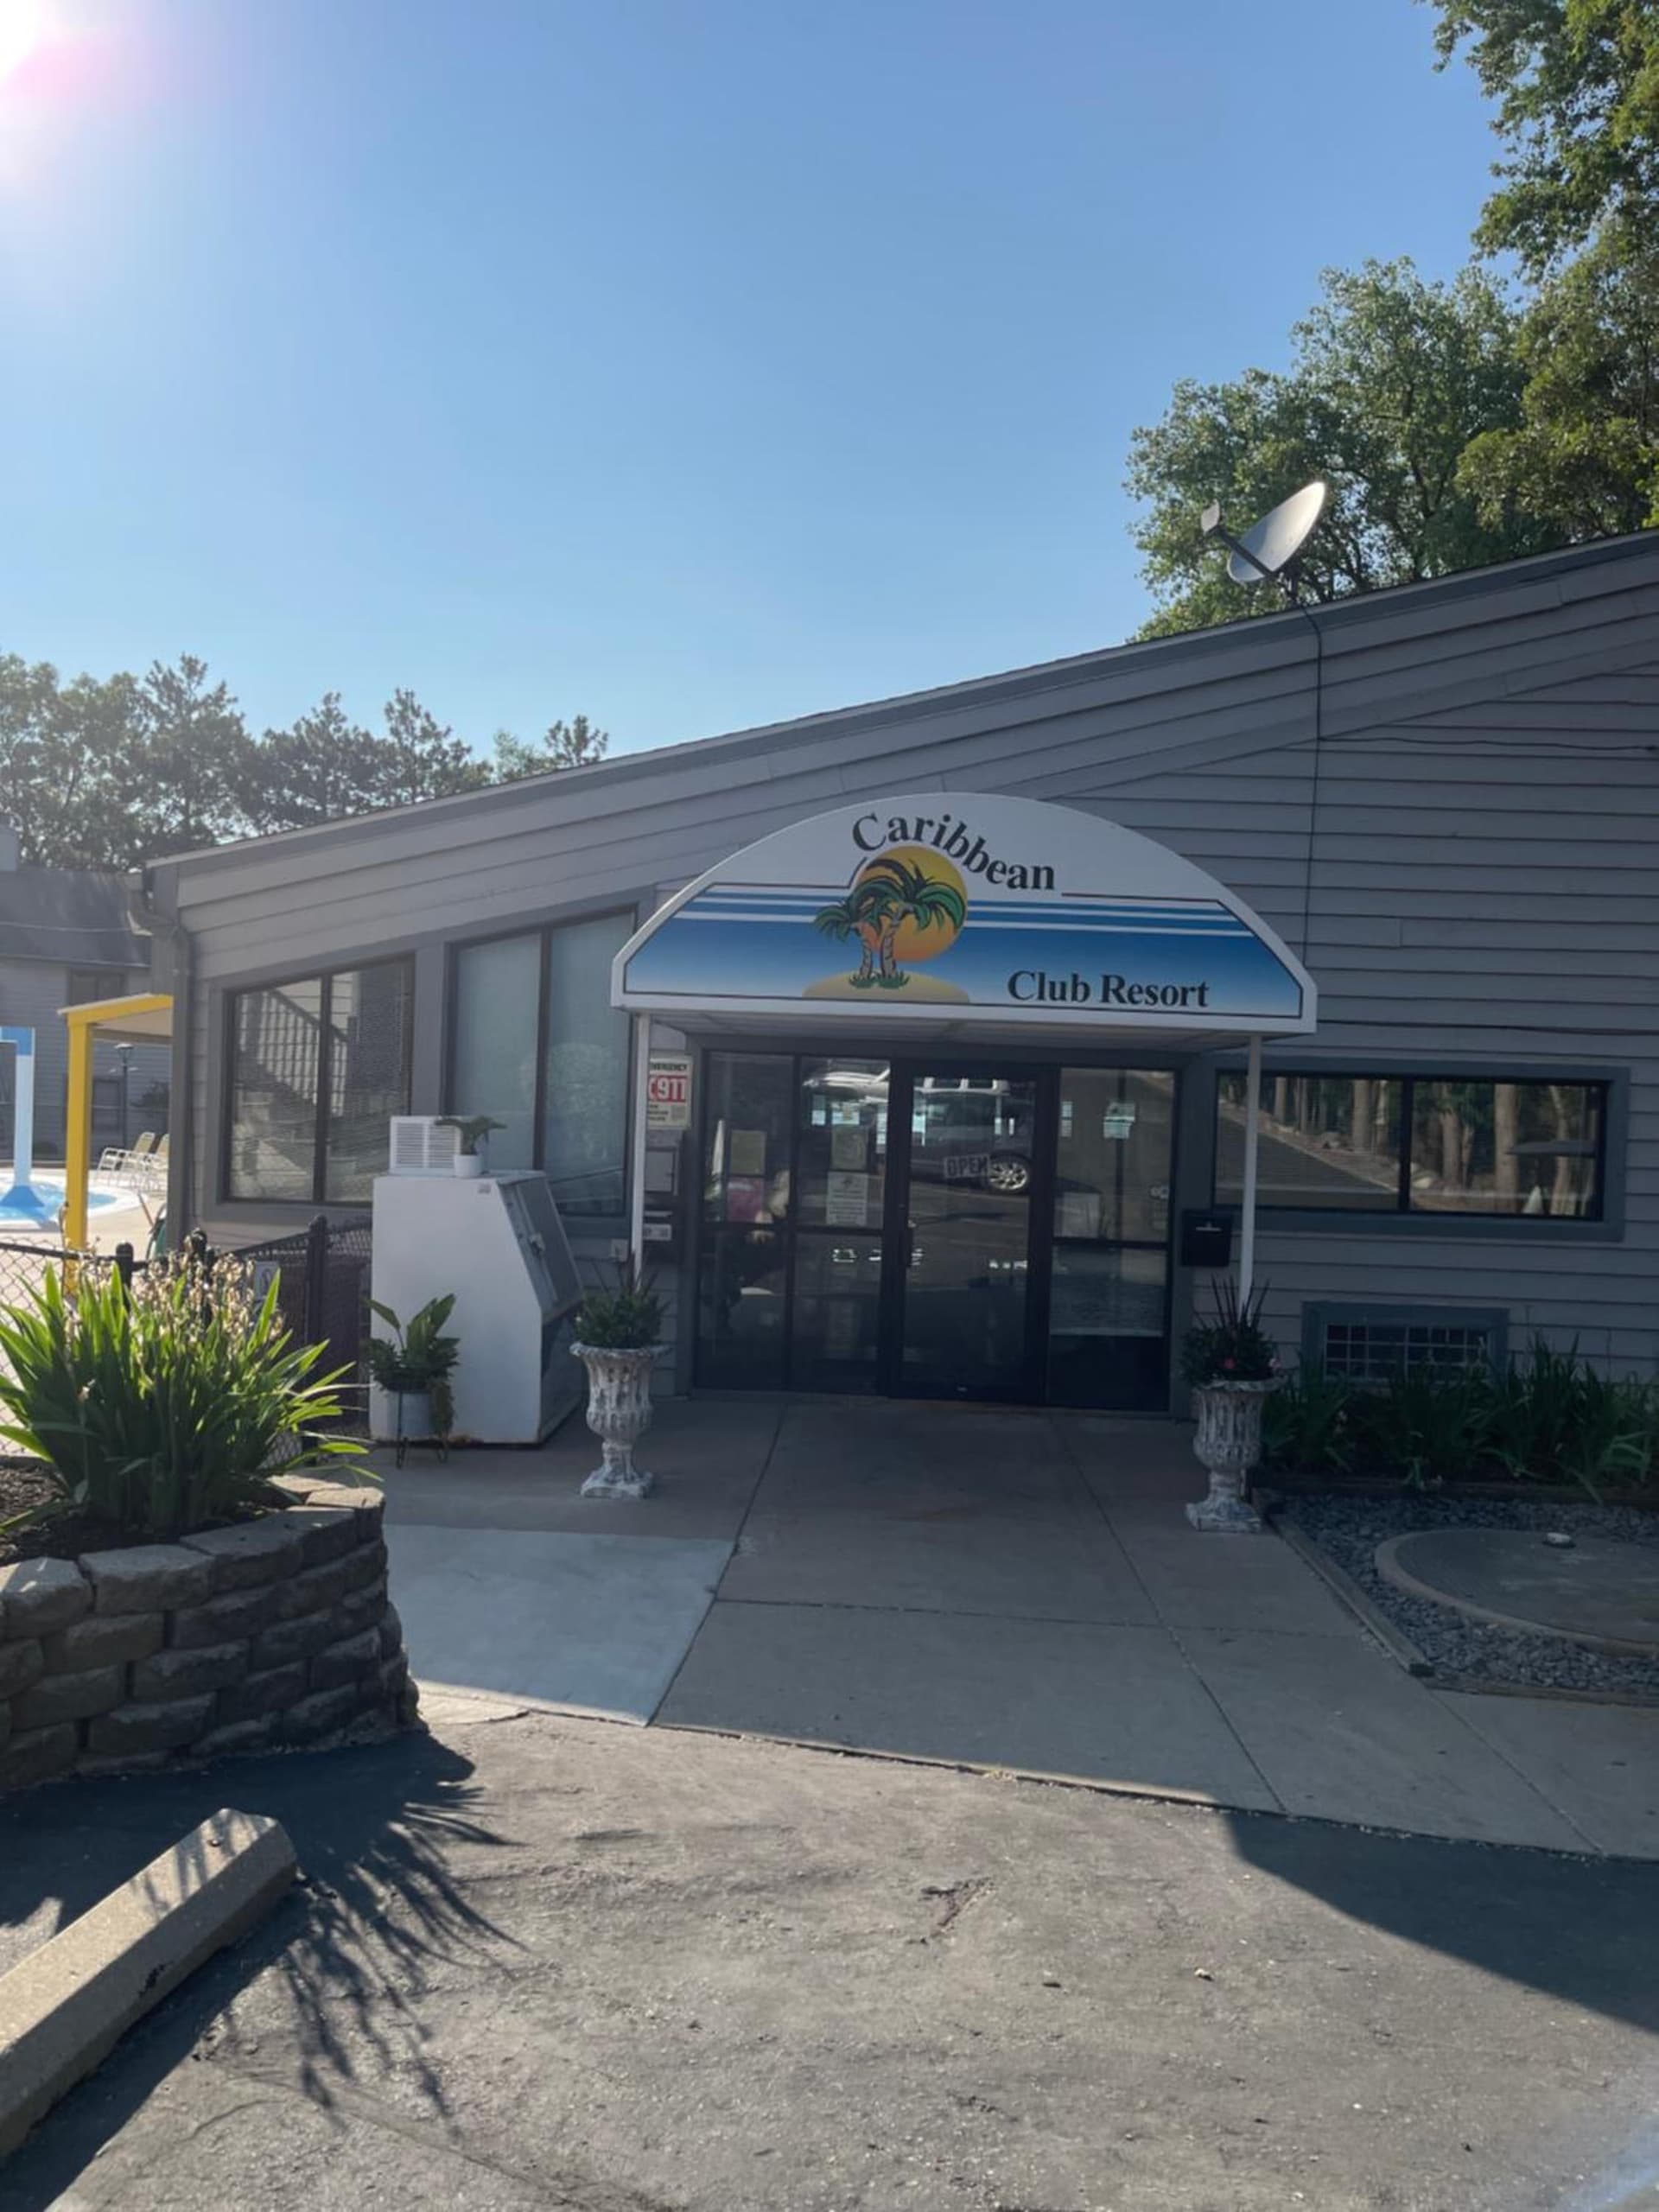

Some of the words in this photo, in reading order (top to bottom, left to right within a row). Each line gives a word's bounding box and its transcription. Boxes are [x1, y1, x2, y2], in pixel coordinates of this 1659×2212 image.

[853, 813, 1055, 890] Caribbean
[1007, 969, 1091, 1003] Club
[1100, 974, 1210, 1007] Resort
[658, 1077, 686, 1100] 911
[947, 1156, 988, 1177] OPEN
